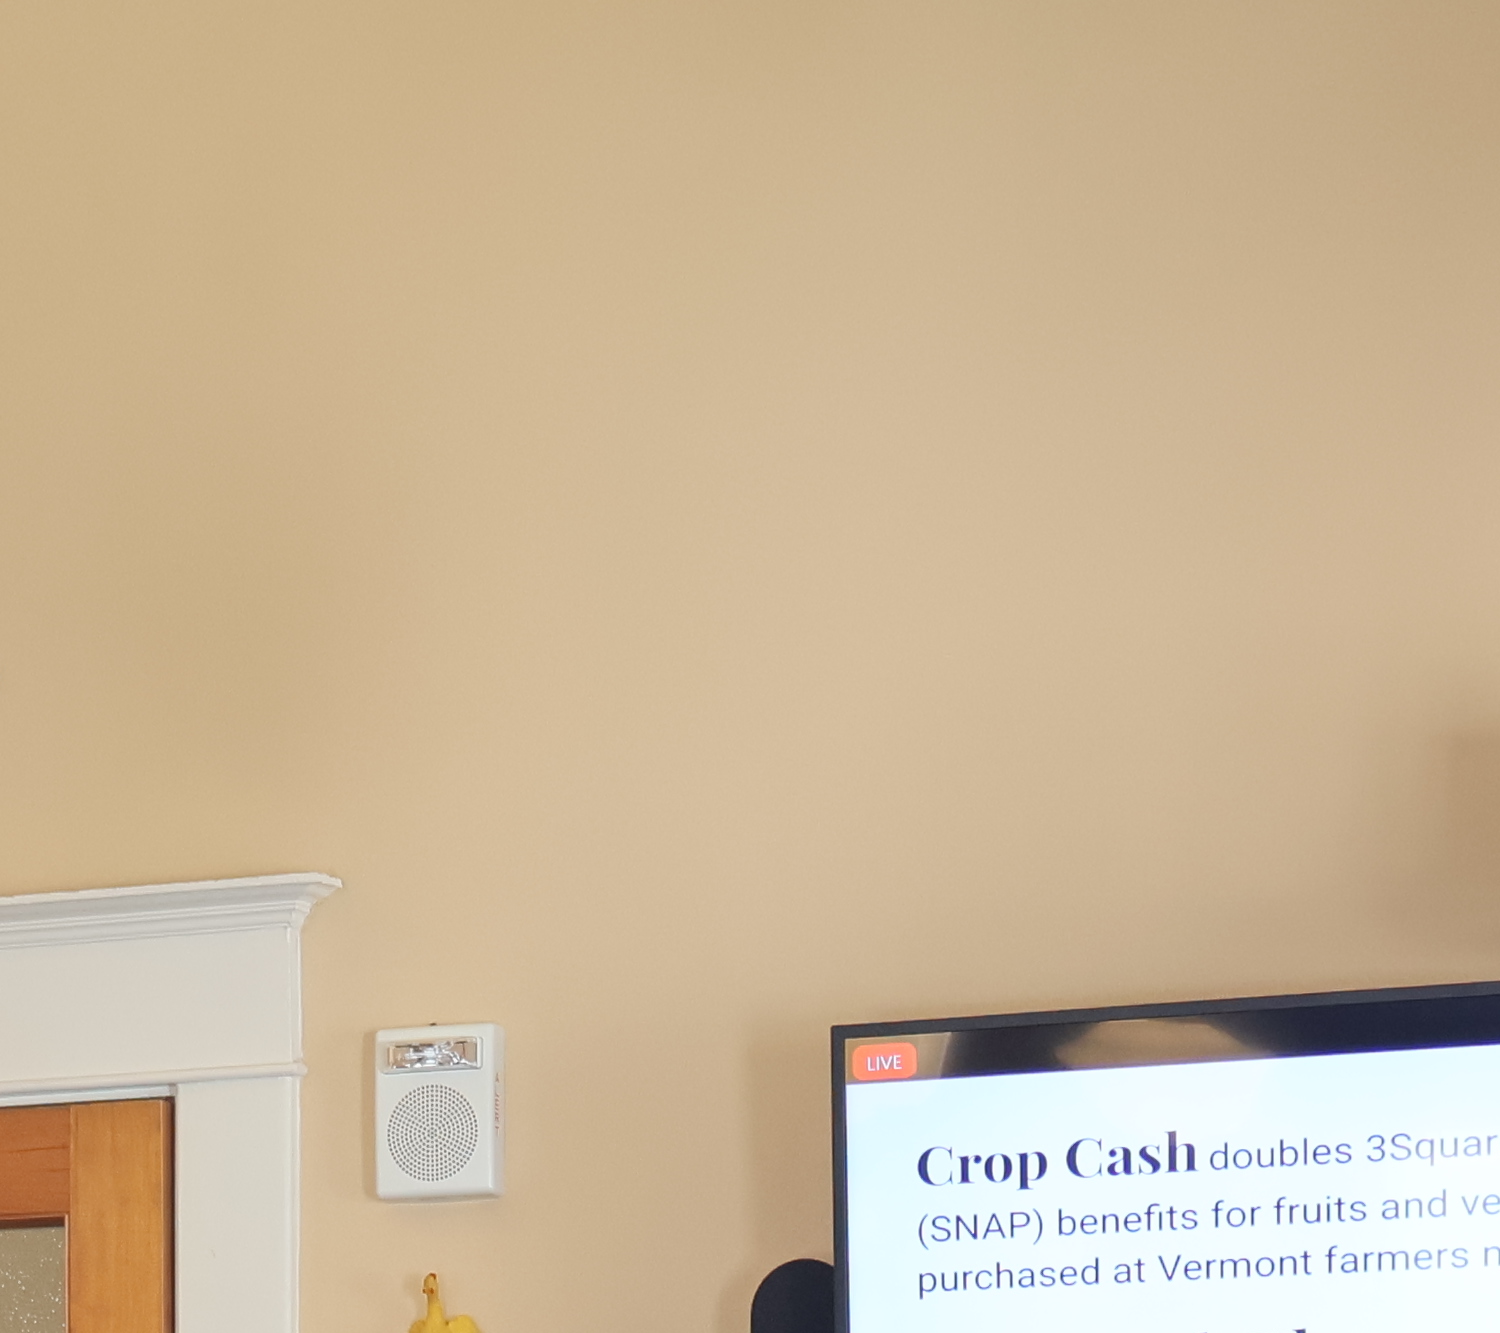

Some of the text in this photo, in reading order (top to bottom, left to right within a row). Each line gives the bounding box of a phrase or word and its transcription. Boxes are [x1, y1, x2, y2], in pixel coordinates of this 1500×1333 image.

[867, 1054, 902, 1072] LIVE
[918, 1147, 1047, 1190] Crop
[1066, 1131, 1197, 1178] Cash
[1210, 1138, 1352, 1170] doubles
[918, 1209, 1043, 1250] (SNAP)
[1058, 1203, 1198, 1235] benefits
[1212, 1200, 1261, 1228] for
[1274, 1196, 1366, 1225] fruits
[1382, 1189, 1446, 1220] and
[919, 1257, 1099, 1300] purchased
[1114, 1258, 1145, 1283] at
[1158, 1251, 1311, 1281] Vermont
[1325, 1245, 1468, 1274] farmers
